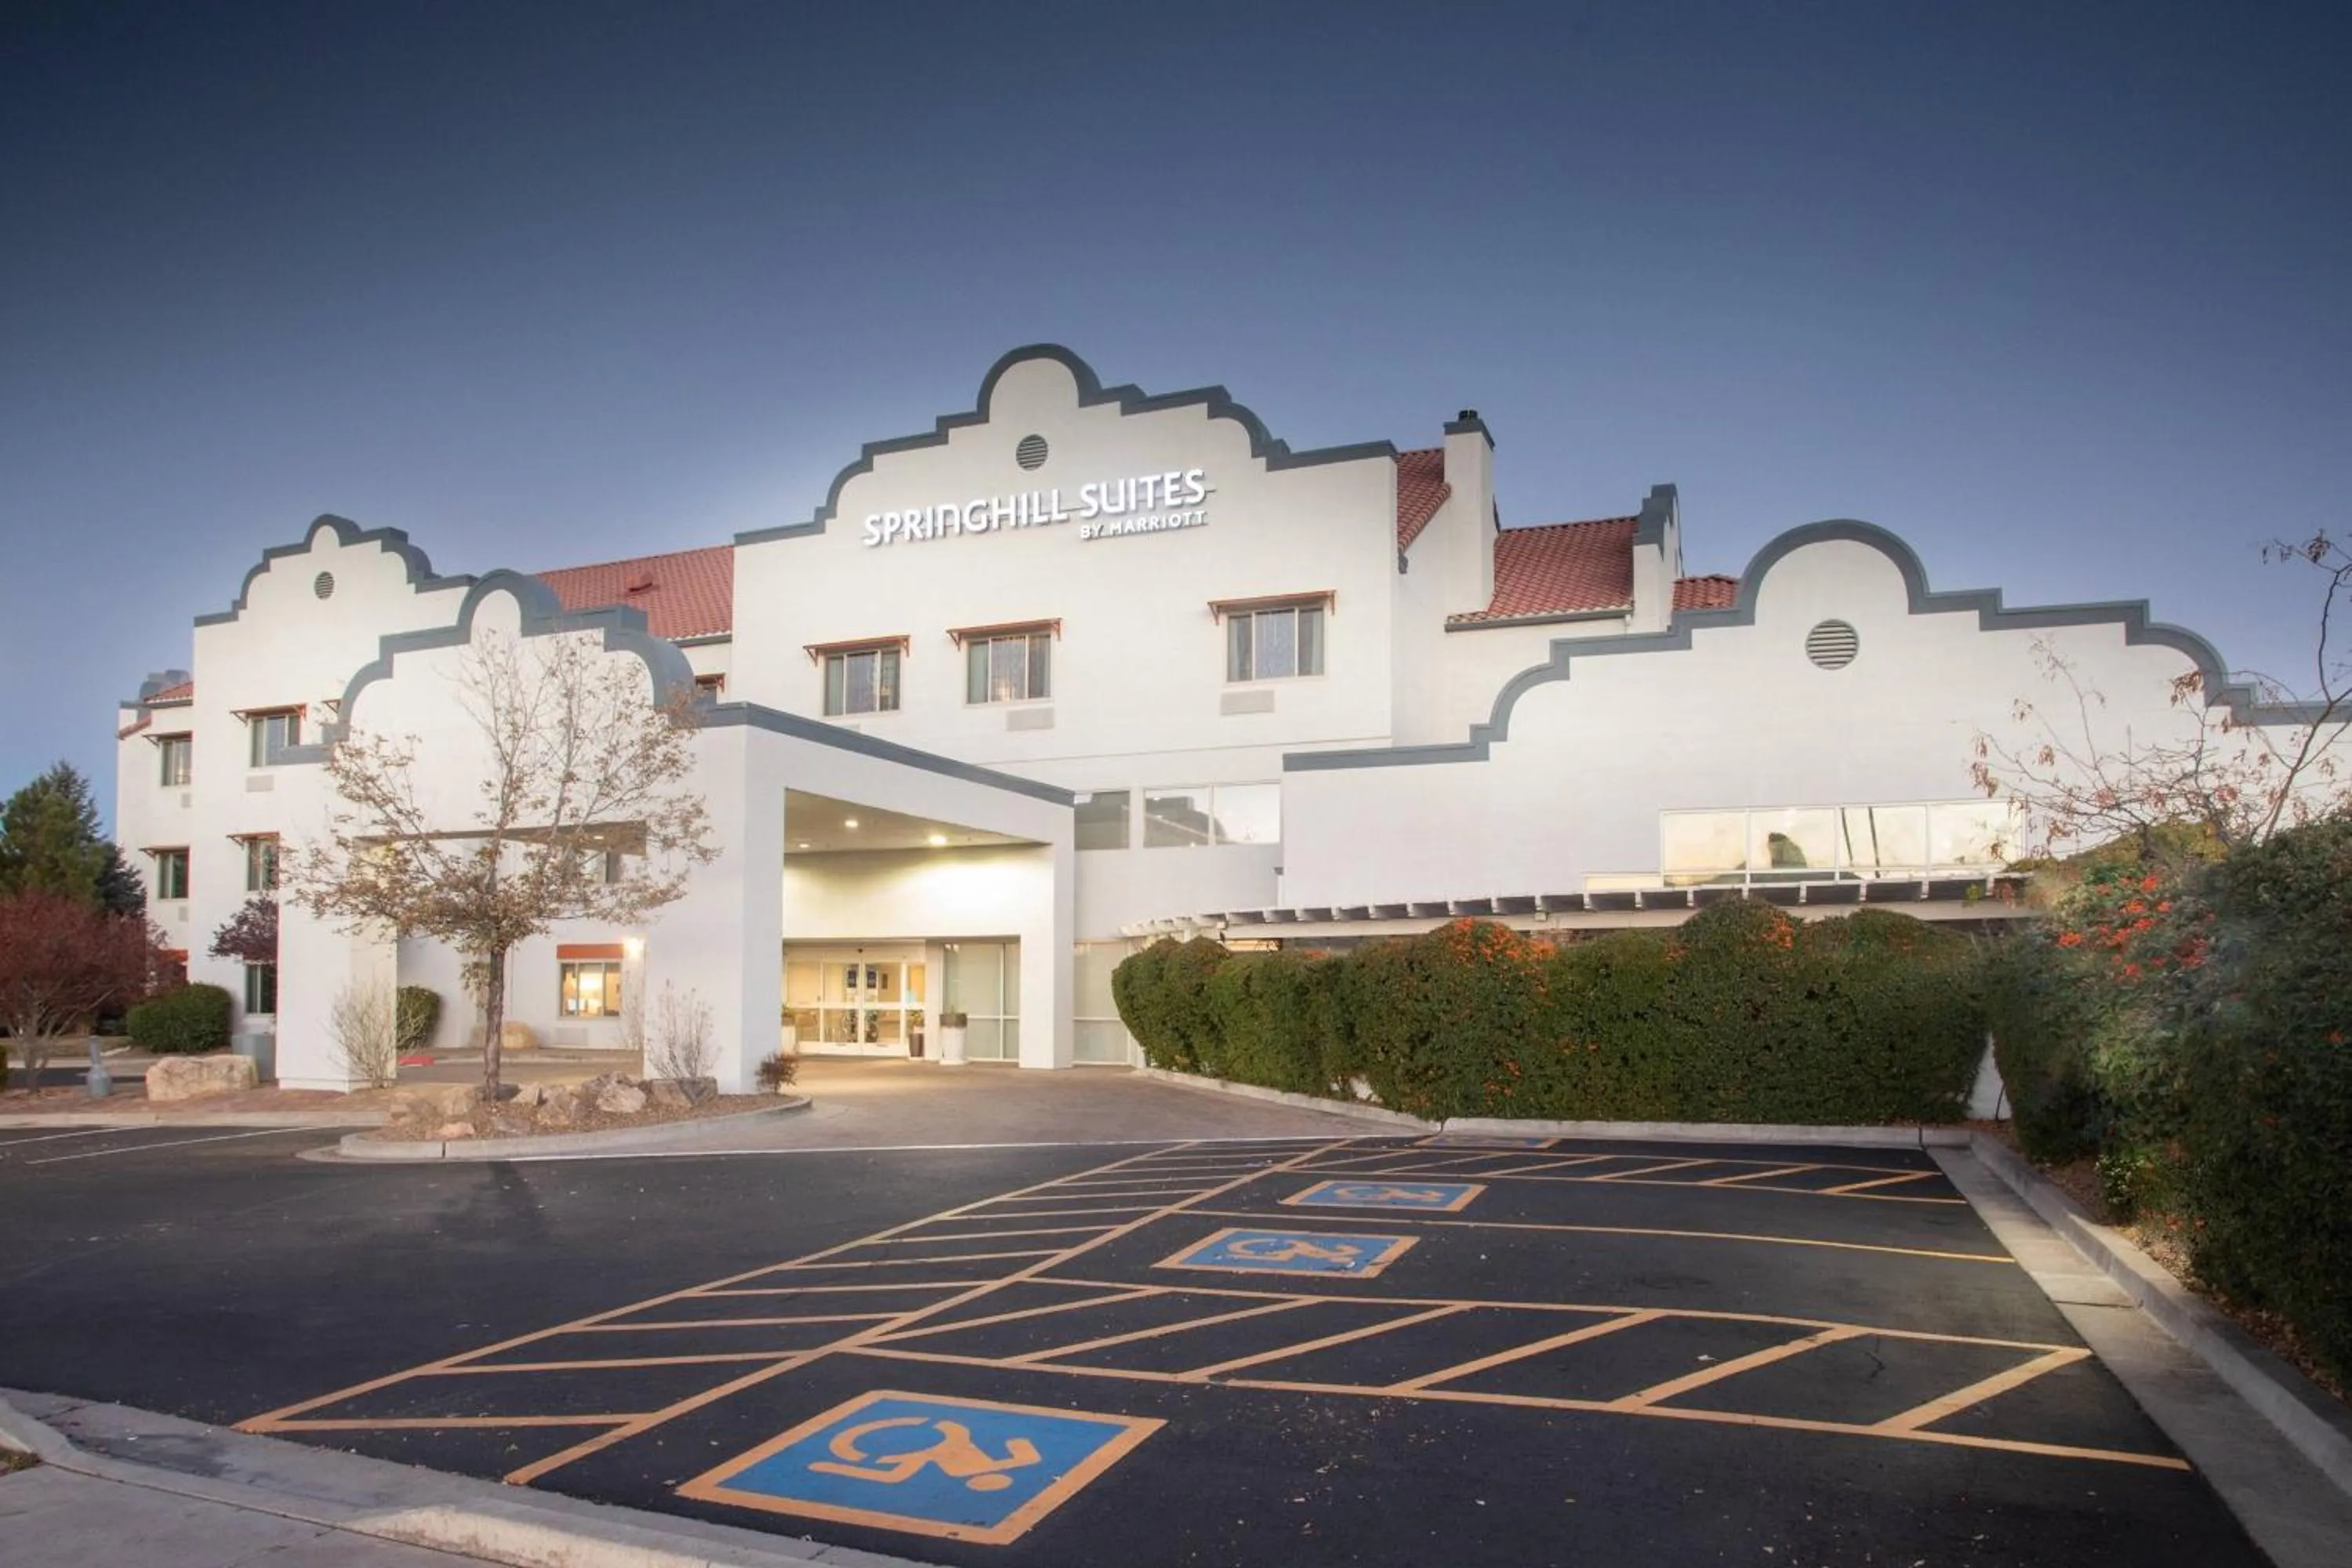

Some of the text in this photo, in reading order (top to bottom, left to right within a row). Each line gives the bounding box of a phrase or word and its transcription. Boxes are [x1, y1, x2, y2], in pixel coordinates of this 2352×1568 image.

[863, 470, 1206, 546] SPRINGHILL SUITES
[1080, 510, 1207, 540] BY MARRIOTT
